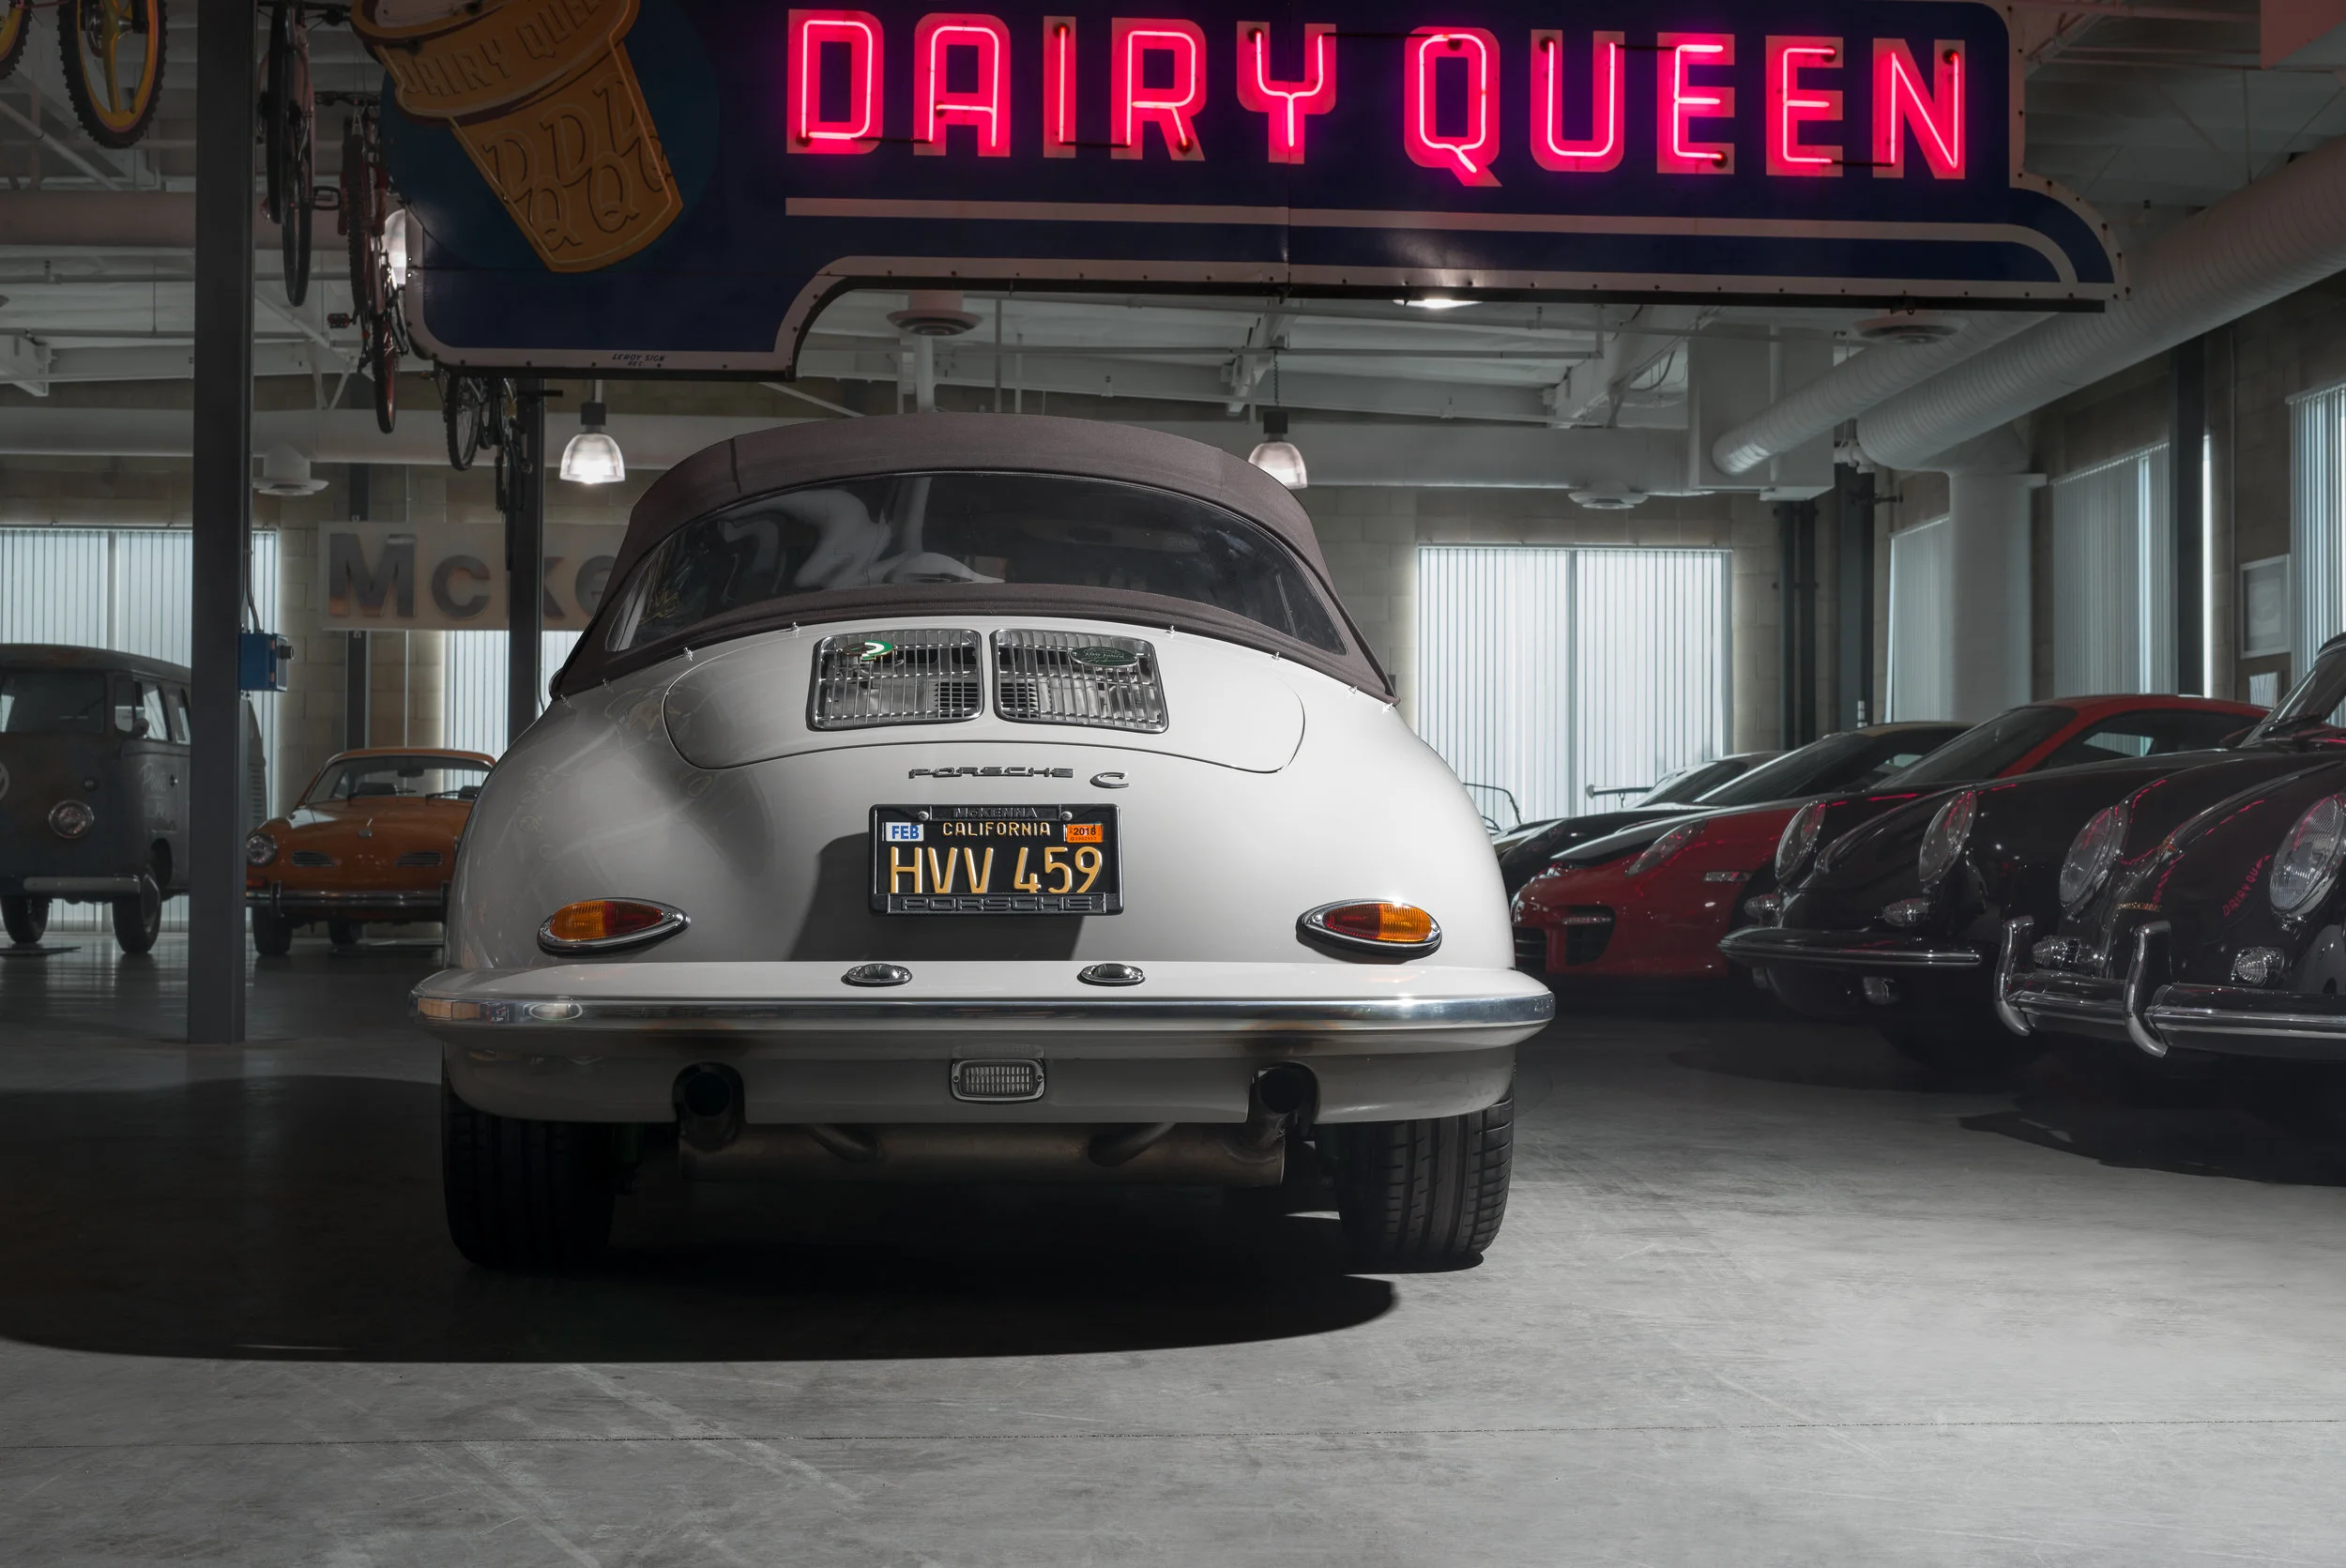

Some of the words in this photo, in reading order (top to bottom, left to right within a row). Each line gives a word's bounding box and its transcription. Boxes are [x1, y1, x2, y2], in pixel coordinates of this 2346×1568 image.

[397, 38, 512, 98] DAIRY
[787, 9, 1336, 163] DAIRY
[1405, 26, 1965, 186] QUEEN
[645, 354, 665, 362] SIGN
[908, 766, 1074, 779] PORSCHE
[1089, 771, 1129, 788] C
[891, 825, 920, 840] FEB
[942, 822, 1051, 836] CALIFORNIA
[1073, 827, 1097, 836] 2018
[891, 846, 994, 893] HVV
[1013, 846, 1103, 893] 459
[901, 896, 1092, 911] PORSCHE
